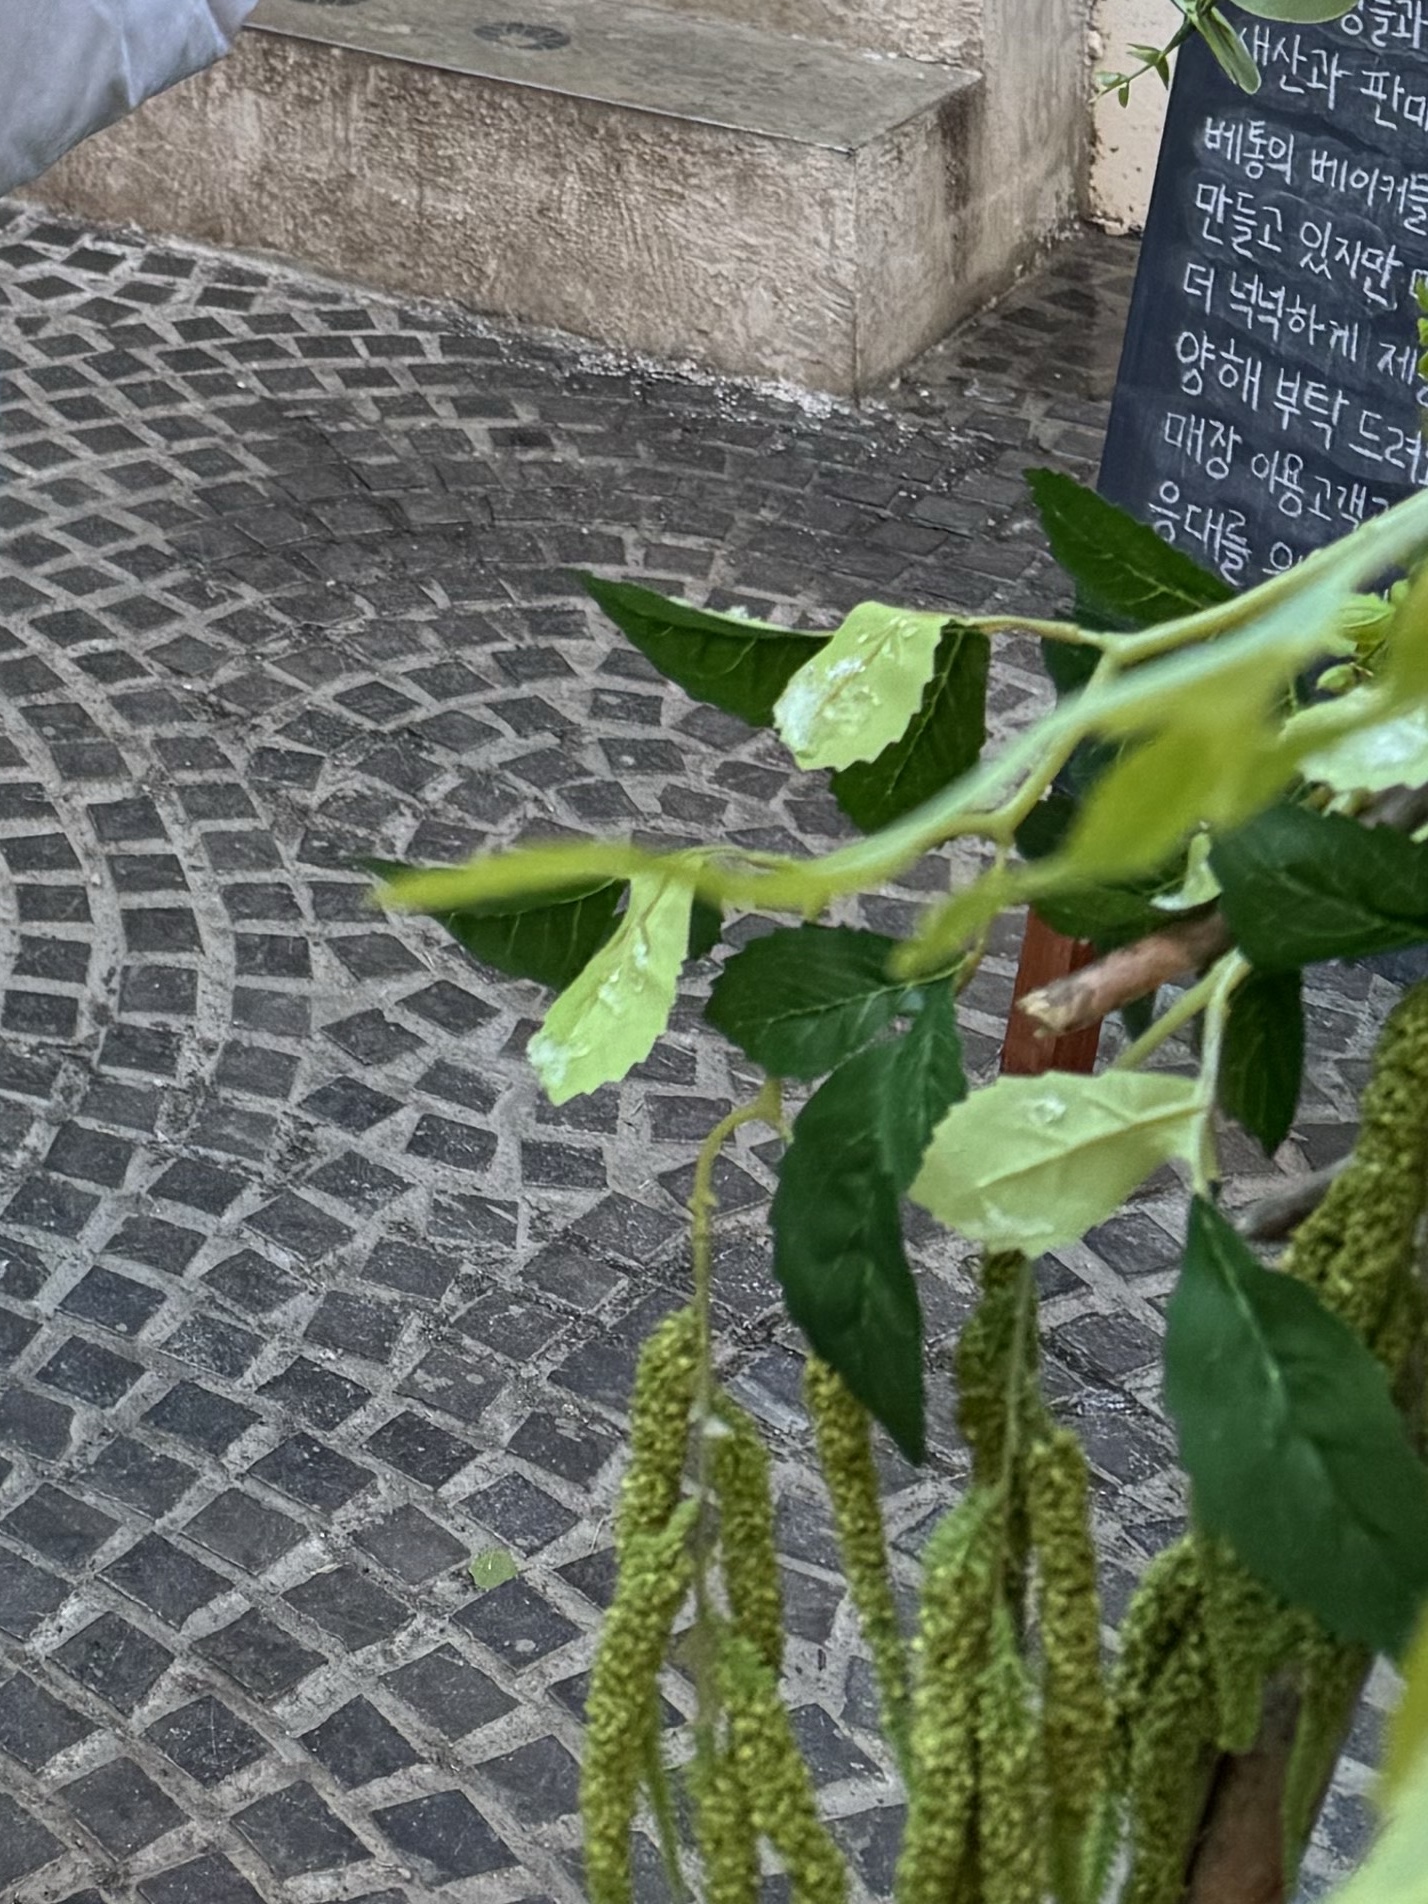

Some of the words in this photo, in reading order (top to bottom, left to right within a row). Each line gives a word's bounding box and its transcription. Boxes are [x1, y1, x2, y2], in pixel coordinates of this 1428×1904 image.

[1204, 117, 1295, 185] 베통의
[1195, 183, 1283, 258] 만들고
[1299, 221, 1405, 308] 있지만
[1182, 262, 1215, 316] 더
[1229, 271, 1359, 363] 넉넉하게
[1164, 411, 1243, 480] 매장
[1175, 330, 1262, 412] 양해
[1273, 367, 1351, 451] 부탁
[1348, 409, 1428, 487] 드려
